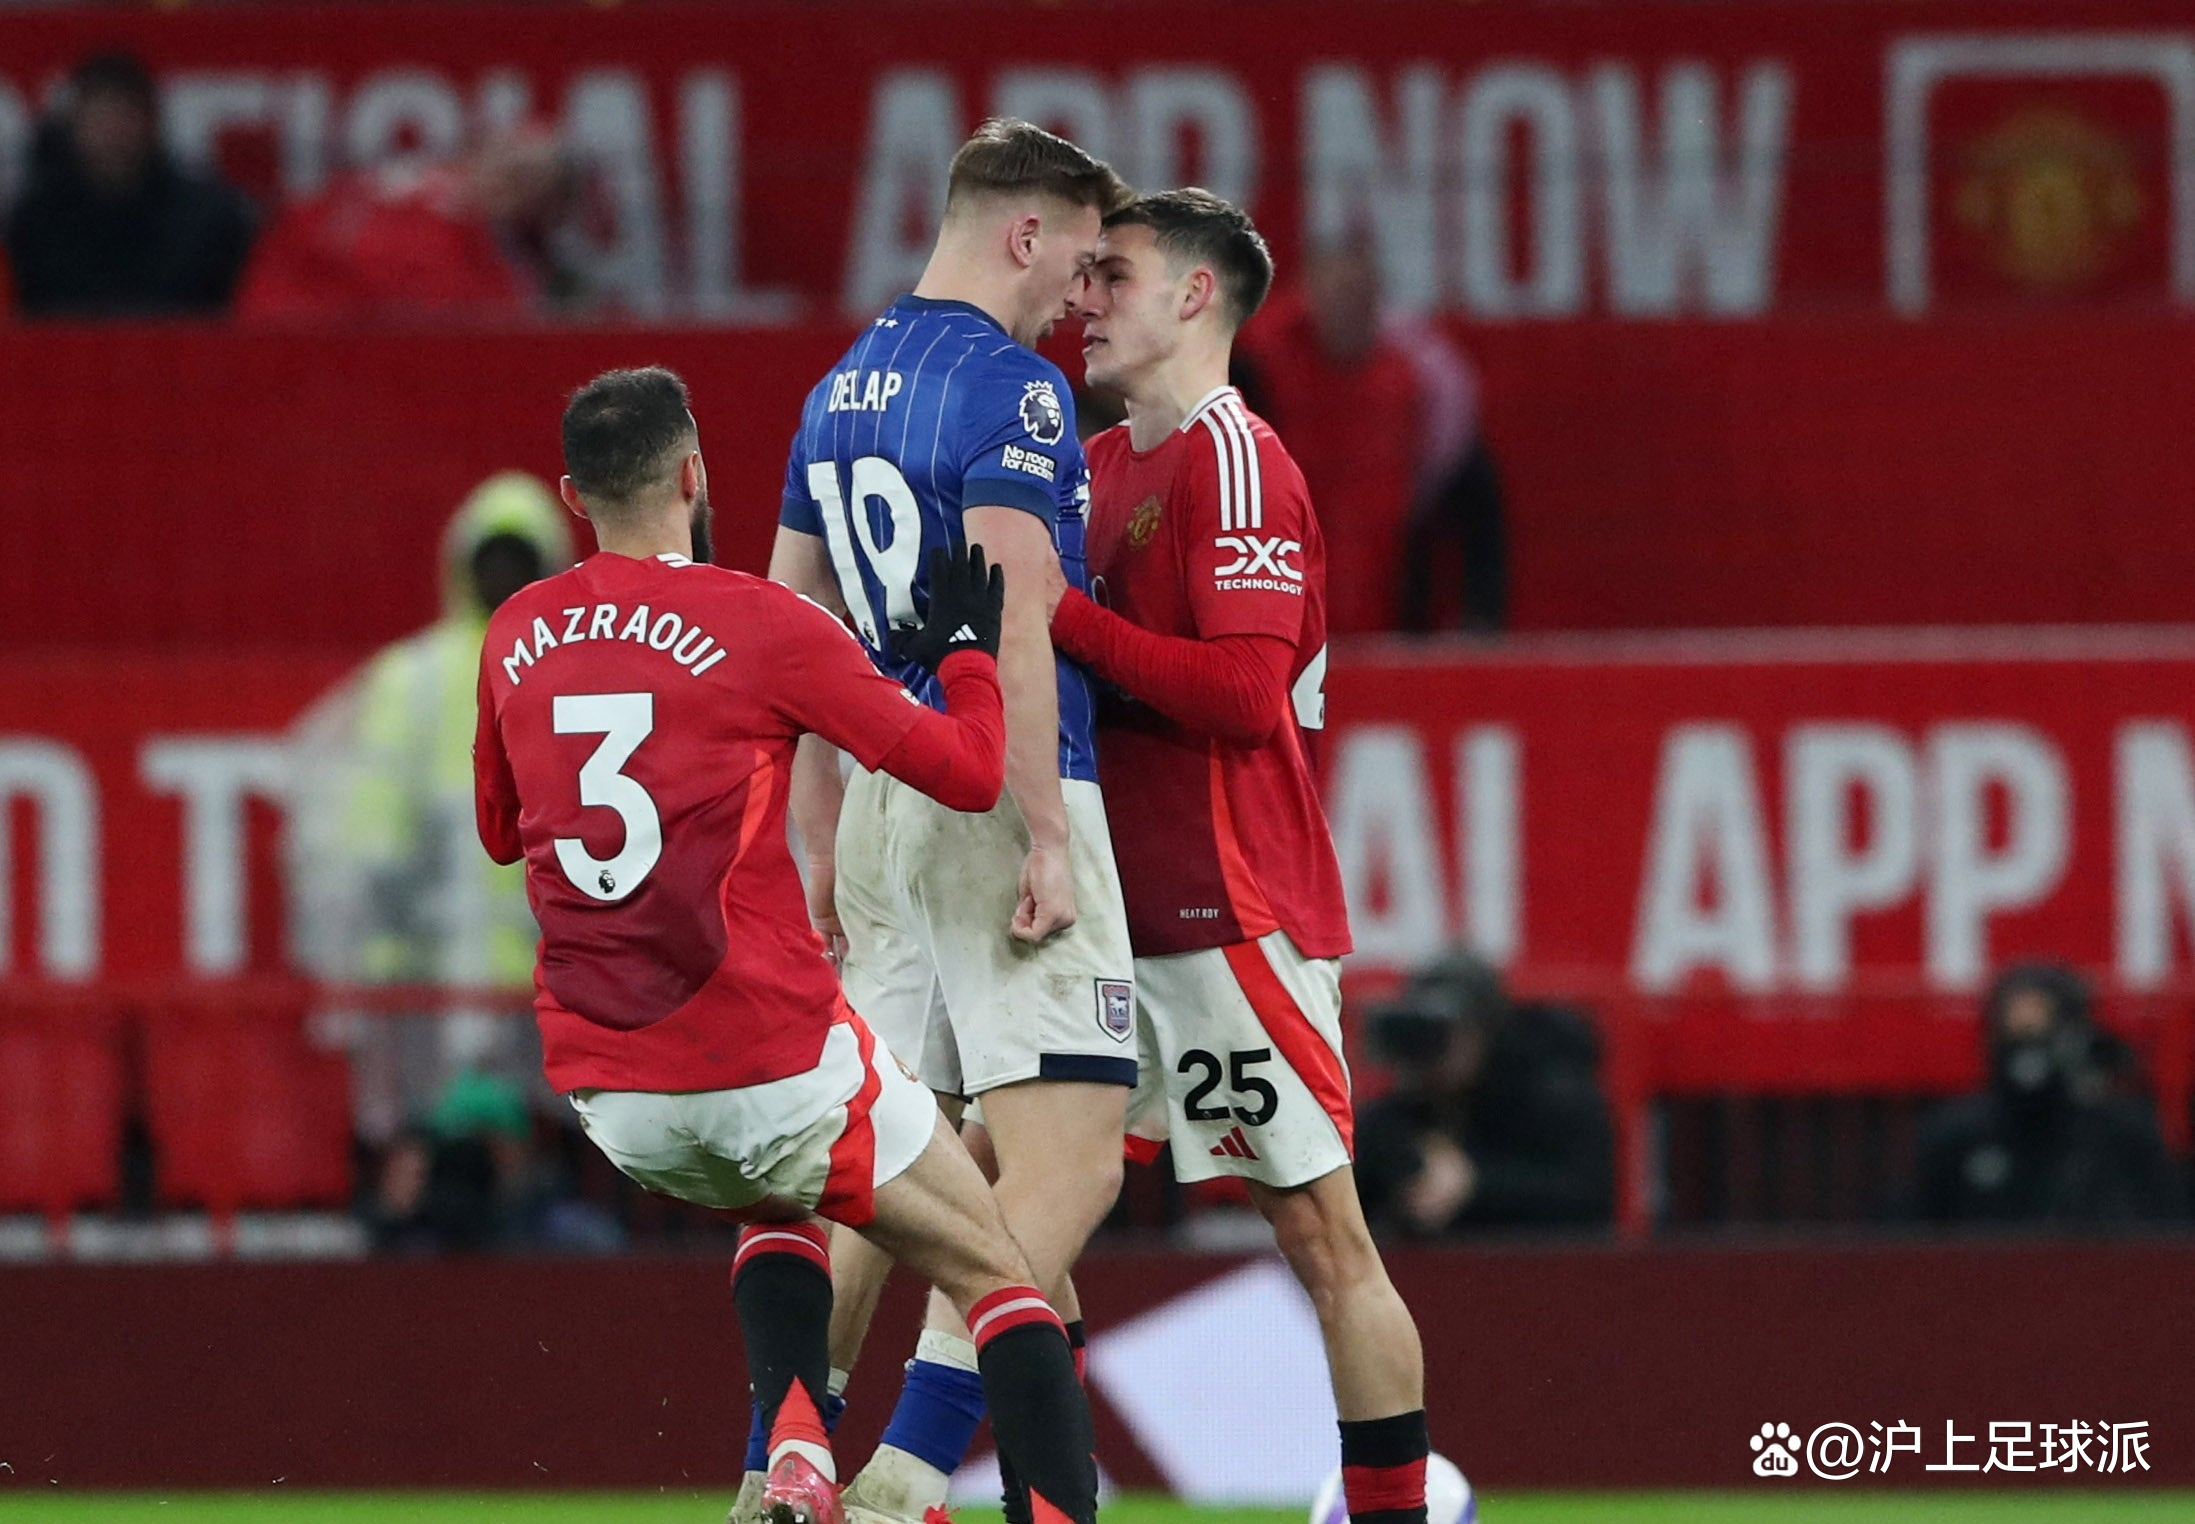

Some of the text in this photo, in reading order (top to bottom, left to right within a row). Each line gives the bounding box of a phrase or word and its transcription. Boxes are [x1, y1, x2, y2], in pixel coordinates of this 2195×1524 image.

[1303, 64, 1792, 318] NOW
[828, 371, 902, 412] DELAP
[1003, 444, 1025, 460] No
[807, 456, 924, 652] 19
[1214, 535, 1303, 580] DXC
[1214, 578, 1303, 596] TECHNOLOGY
[502, 603, 727, 685] MAZRAOUI
[553, 692, 662, 901] 3
[1630, 723, 2071, 995] APP
[1177, 1048, 1278, 1127] 25
